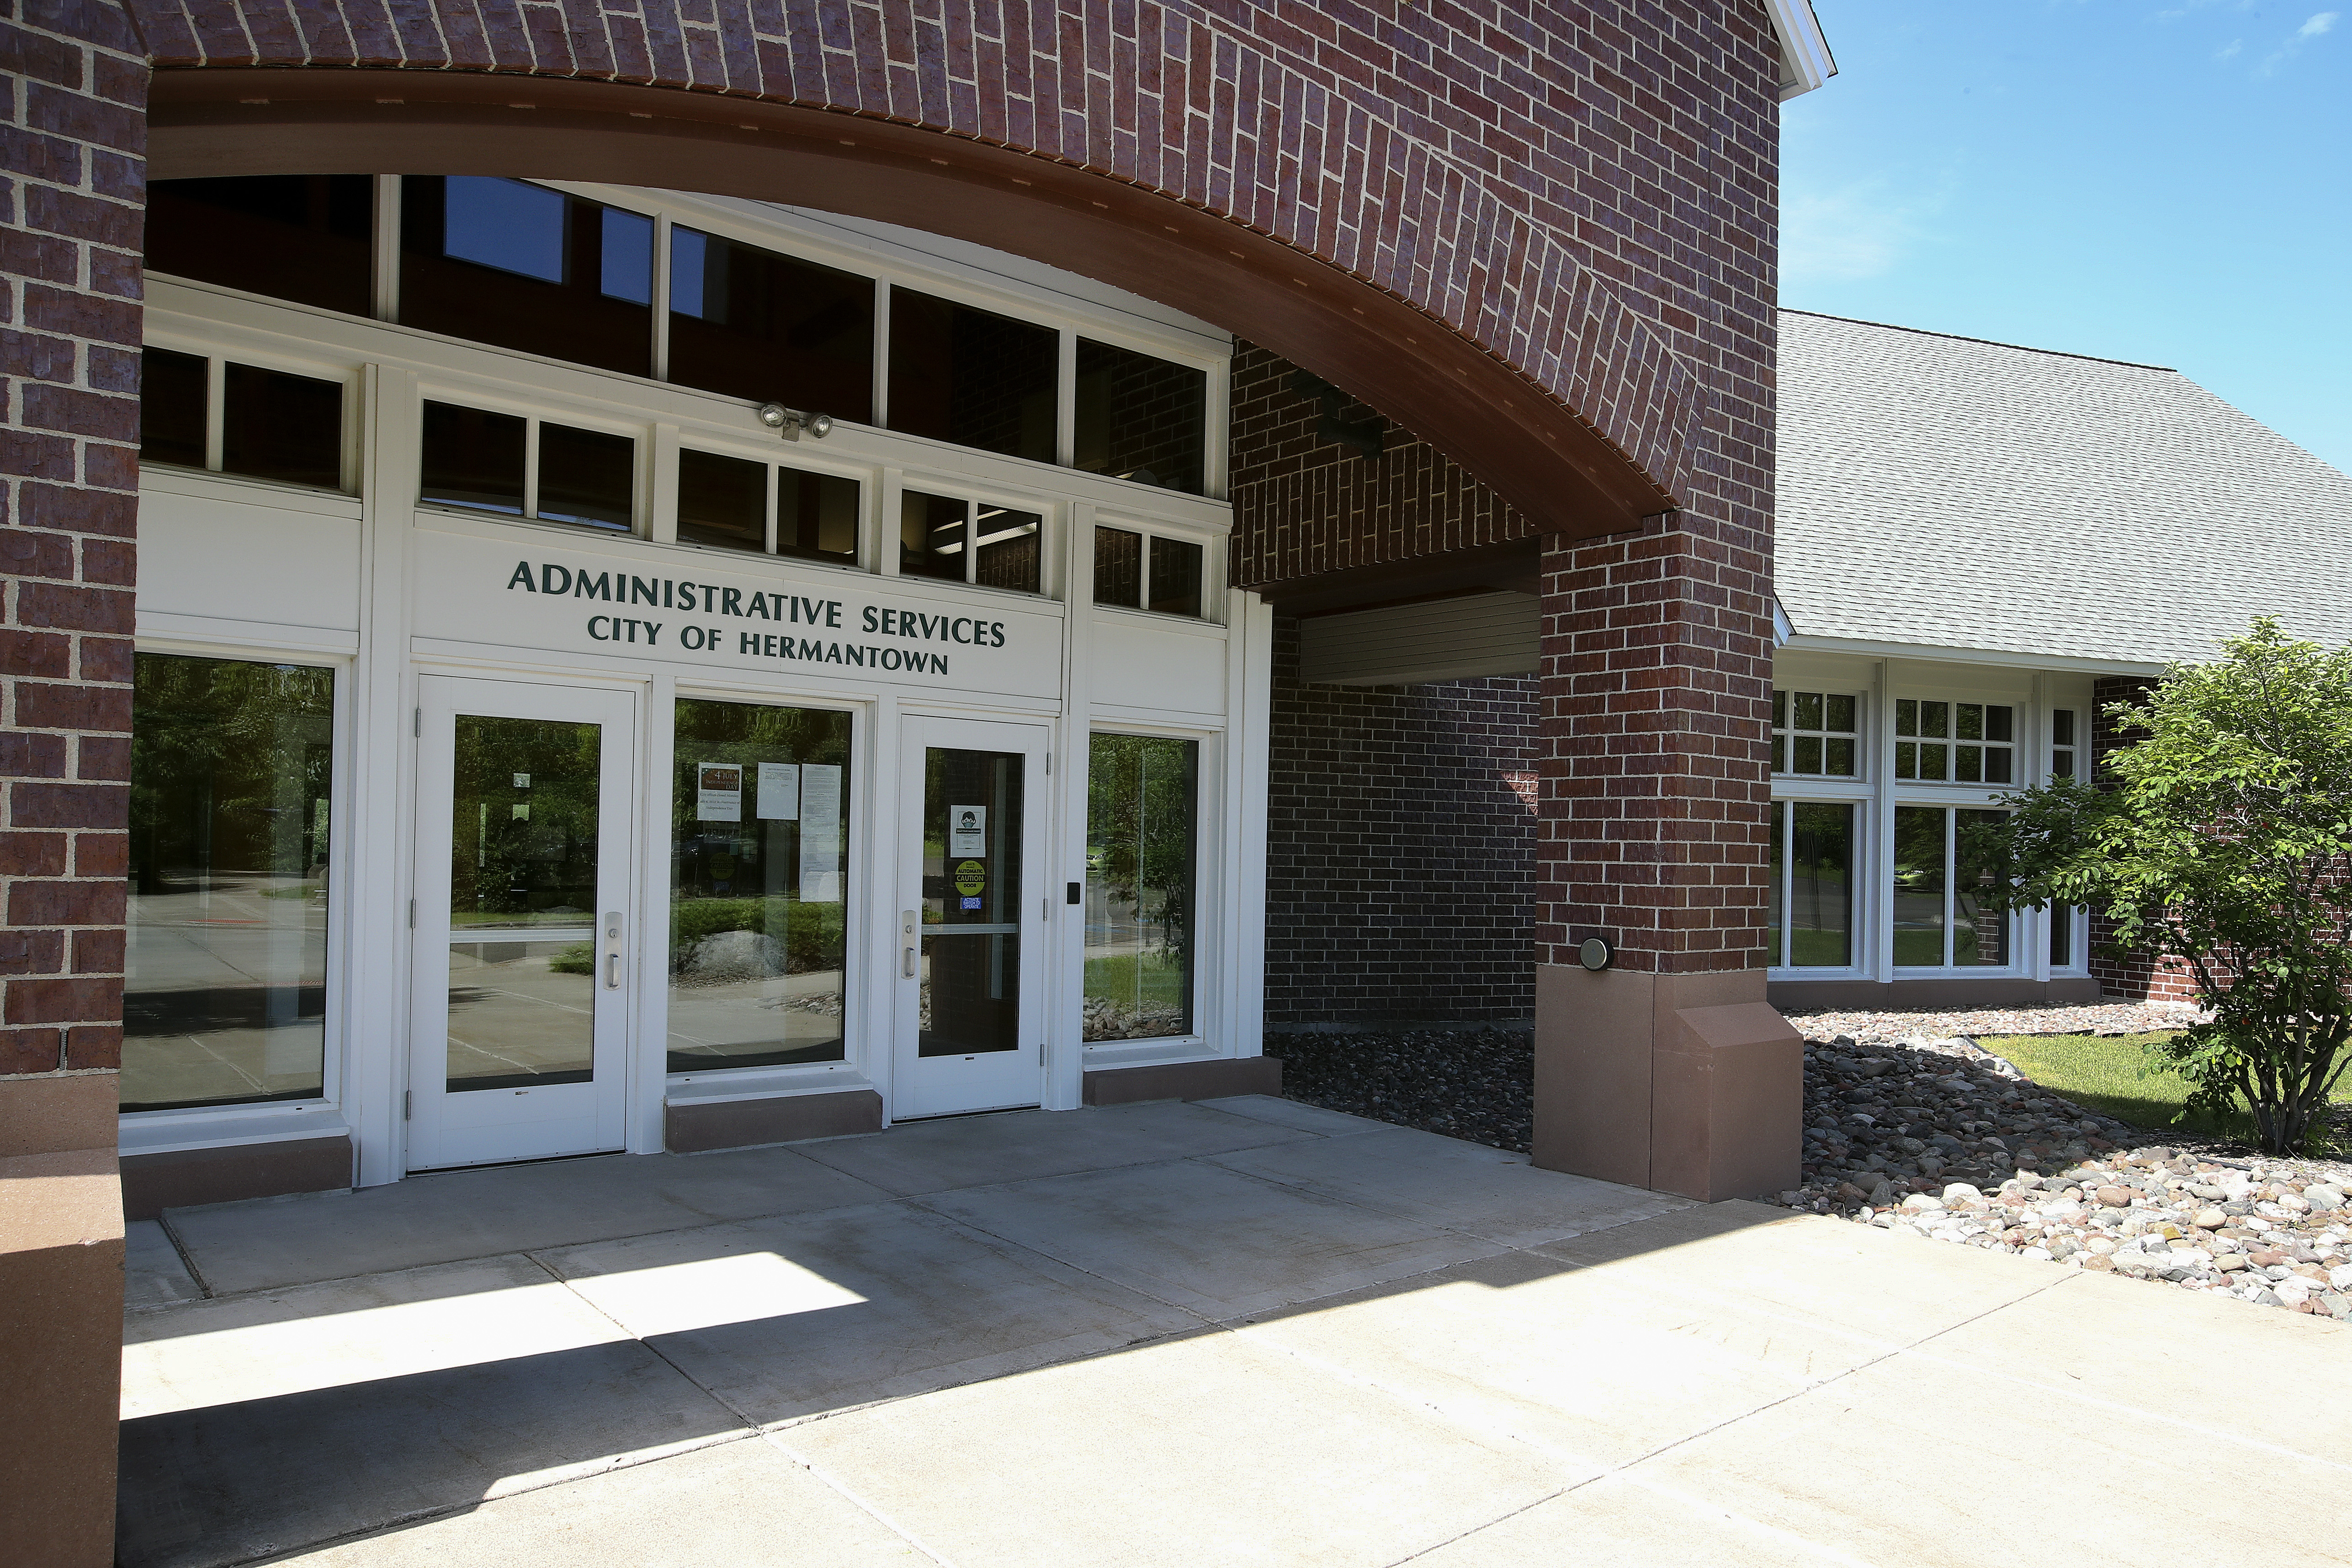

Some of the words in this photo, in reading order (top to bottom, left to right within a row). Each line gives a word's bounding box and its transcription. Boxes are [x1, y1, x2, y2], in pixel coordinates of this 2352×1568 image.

[507, 561, 842, 628] ADMINISTRATIVE
[862, 606, 1005, 648] SERVICES
[587, 615, 663, 645] CITY
[680, 625, 722, 651] OF
[740, 632, 948, 675] HERMANTOWN
[715, 771, 721, 780] 4
